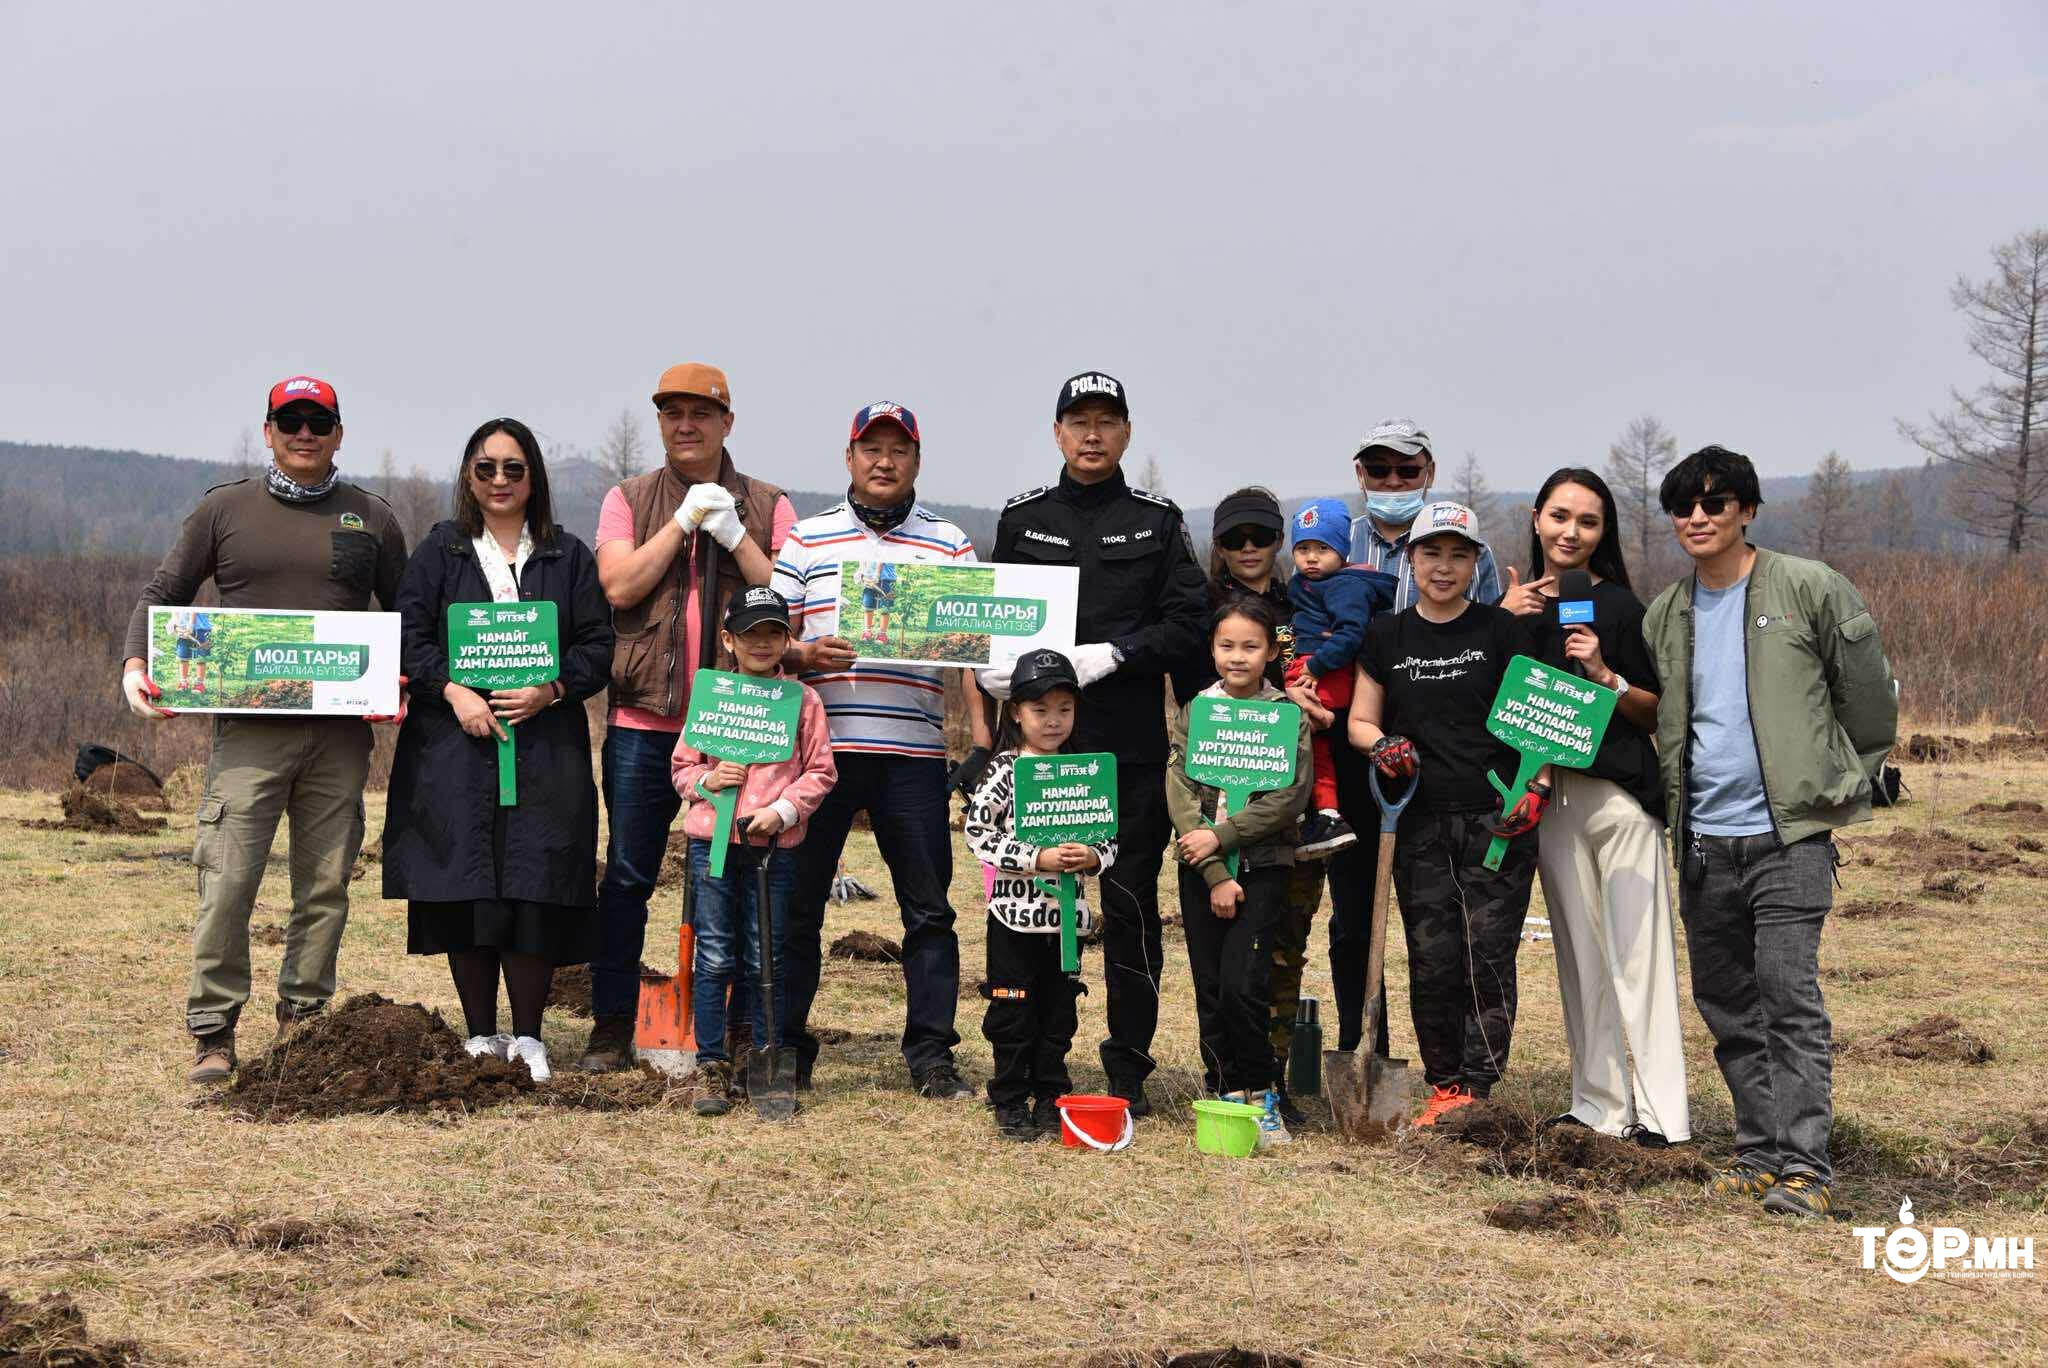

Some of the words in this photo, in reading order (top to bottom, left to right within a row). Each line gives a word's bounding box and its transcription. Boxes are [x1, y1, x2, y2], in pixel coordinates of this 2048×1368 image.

[1071, 375, 1118, 397] POLICE
[1102, 535, 1127, 544] 11042
[936, 601, 978, 617] МОД
[981, 603, 1038, 620] ТАРЬЯ
[935, 616, 993, 629] БАЙГАЛИА
[994, 620, 1038, 632] БҮТЭЭЕ
[477, 630, 529, 643] НАМАЙГ
[460, 642, 548, 656] УРГУУЛААРАЙ
[255, 650, 298, 665] МОД
[304, 650, 360, 666] ТАРЬЯ
[455, 654, 554, 669] ХАМГААЛААРАЙ
[255, 663, 314, 675] БАЙГАЛИА
[317, 667, 360, 677] БҮТЭЭЕ
[718, 701, 771, 718] НАМАЙГ
[1526, 692, 1580, 721] НАМАЙГ
[698, 711, 786, 734] УРГУУЛААРАЙ
[1505, 698, 1593, 740] УРГУУЛААРАЙ
[690, 722, 790, 747] ХАМГААЛААРАЙ
[1216, 729, 1268, 744] НАМАЙГ
[1495, 708, 1593, 755] ХАМГААЛААРАЙ
[1198, 741, 1285, 759] УРГУУЛААРАЙ
[1191, 753, 1290, 773] ХАМГААЛААРАЙ
[1060, 767, 1088, 777] БҮТЭЭЕ
[1042, 784, 1091, 799] НАМАЙГ
[1025, 796, 1109, 813] УРГУУЛААРАЙ
[1021, 809, 1114, 827] ХАМГААЛААРАЙ
